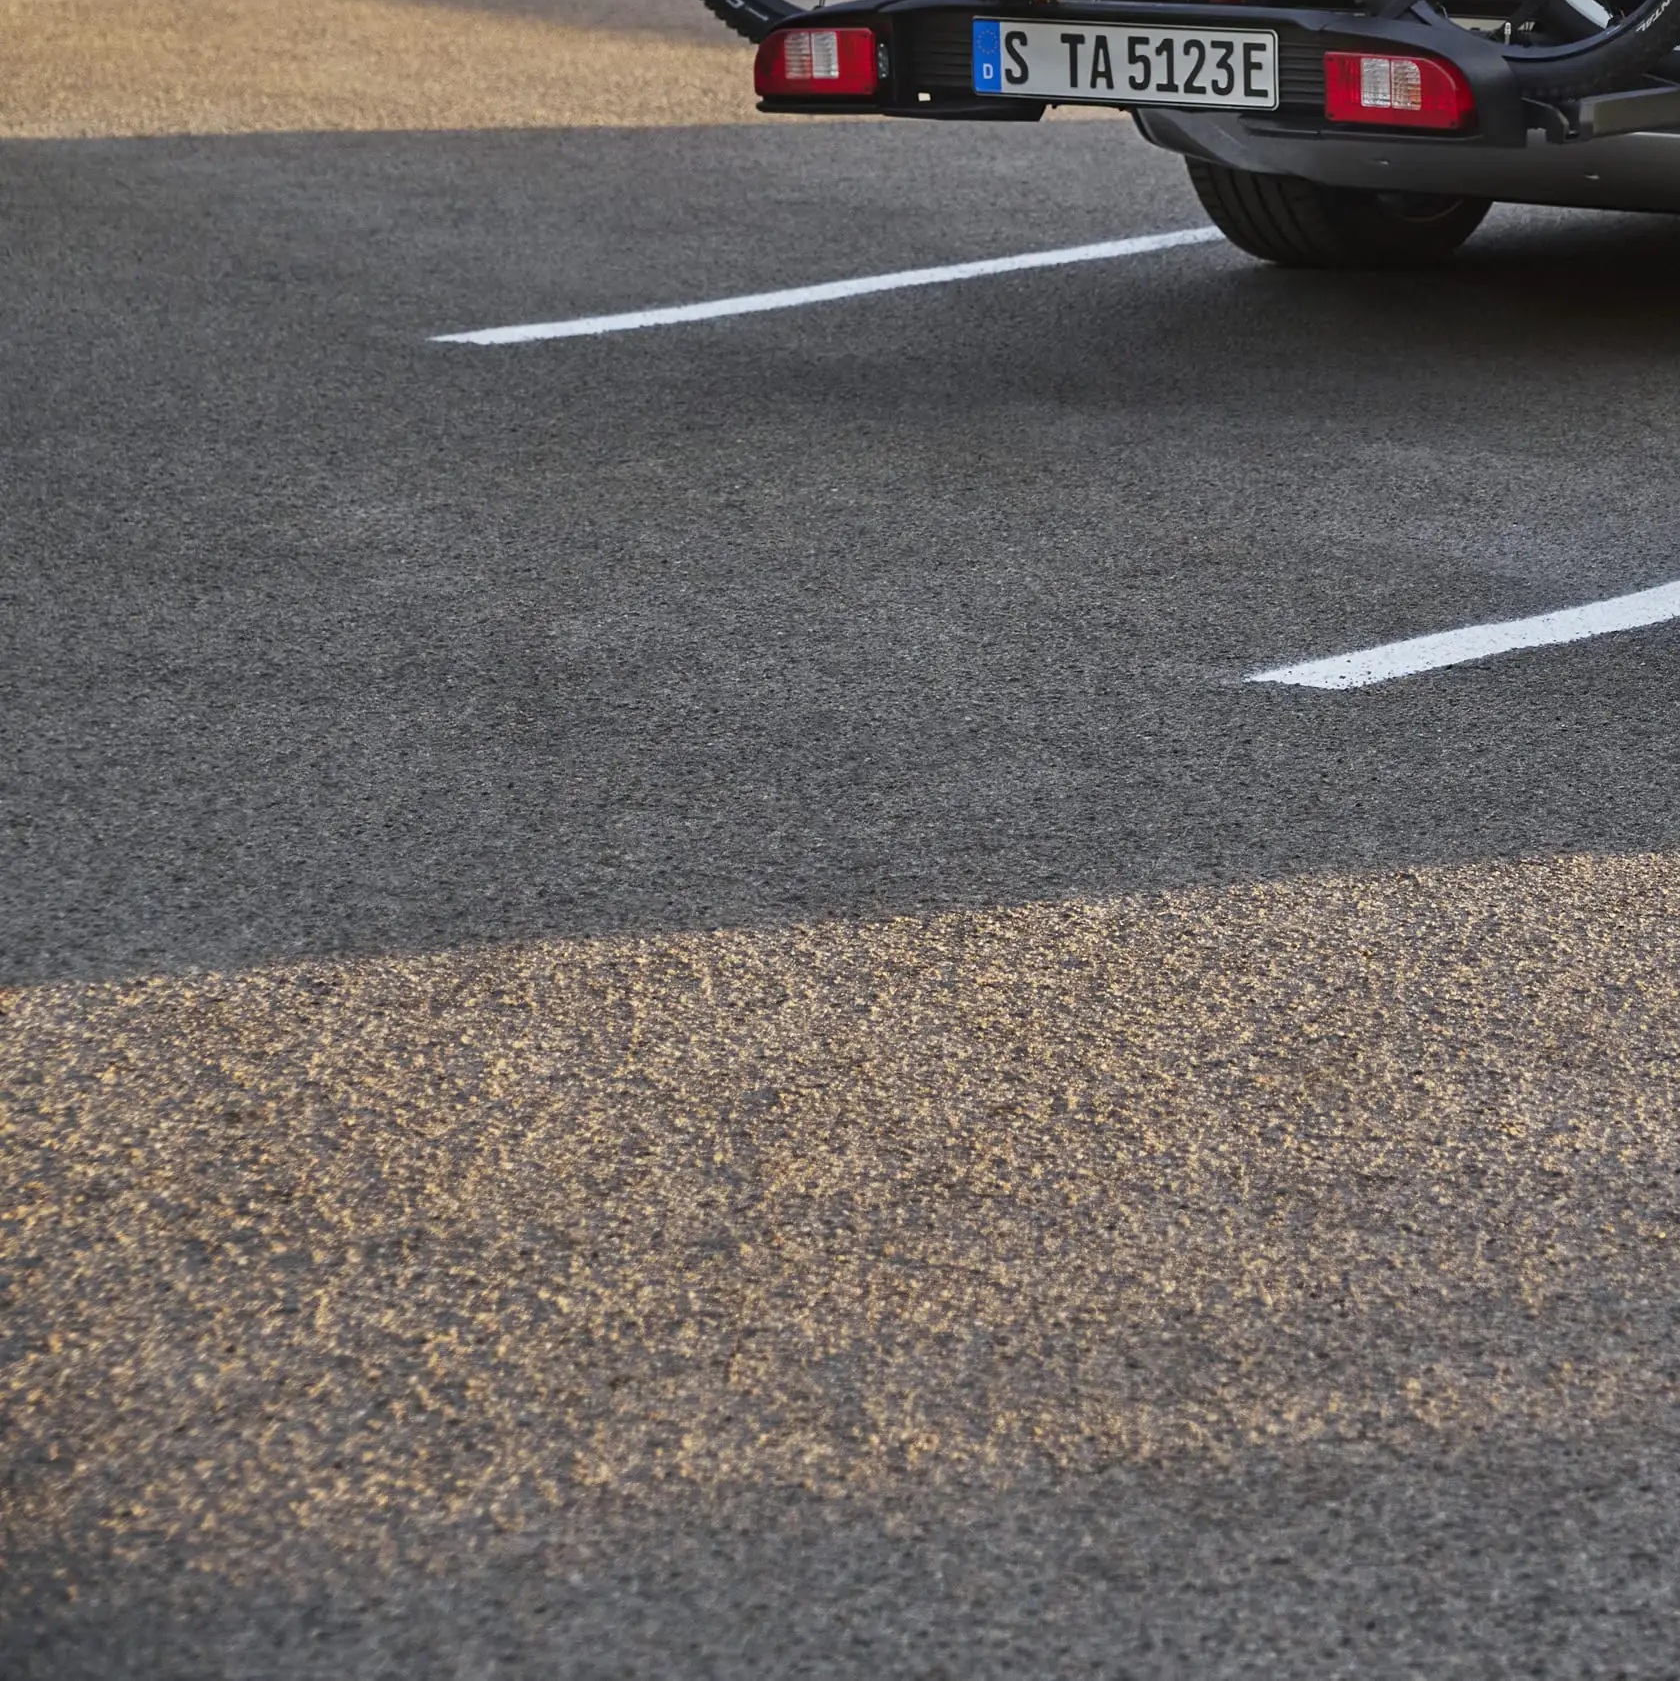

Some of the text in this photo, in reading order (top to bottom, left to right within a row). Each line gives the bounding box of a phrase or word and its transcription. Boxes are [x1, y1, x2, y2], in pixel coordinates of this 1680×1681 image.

[982, 63, 995, 80] D
[1005, 30, 1269, 99] S TA 5123E
